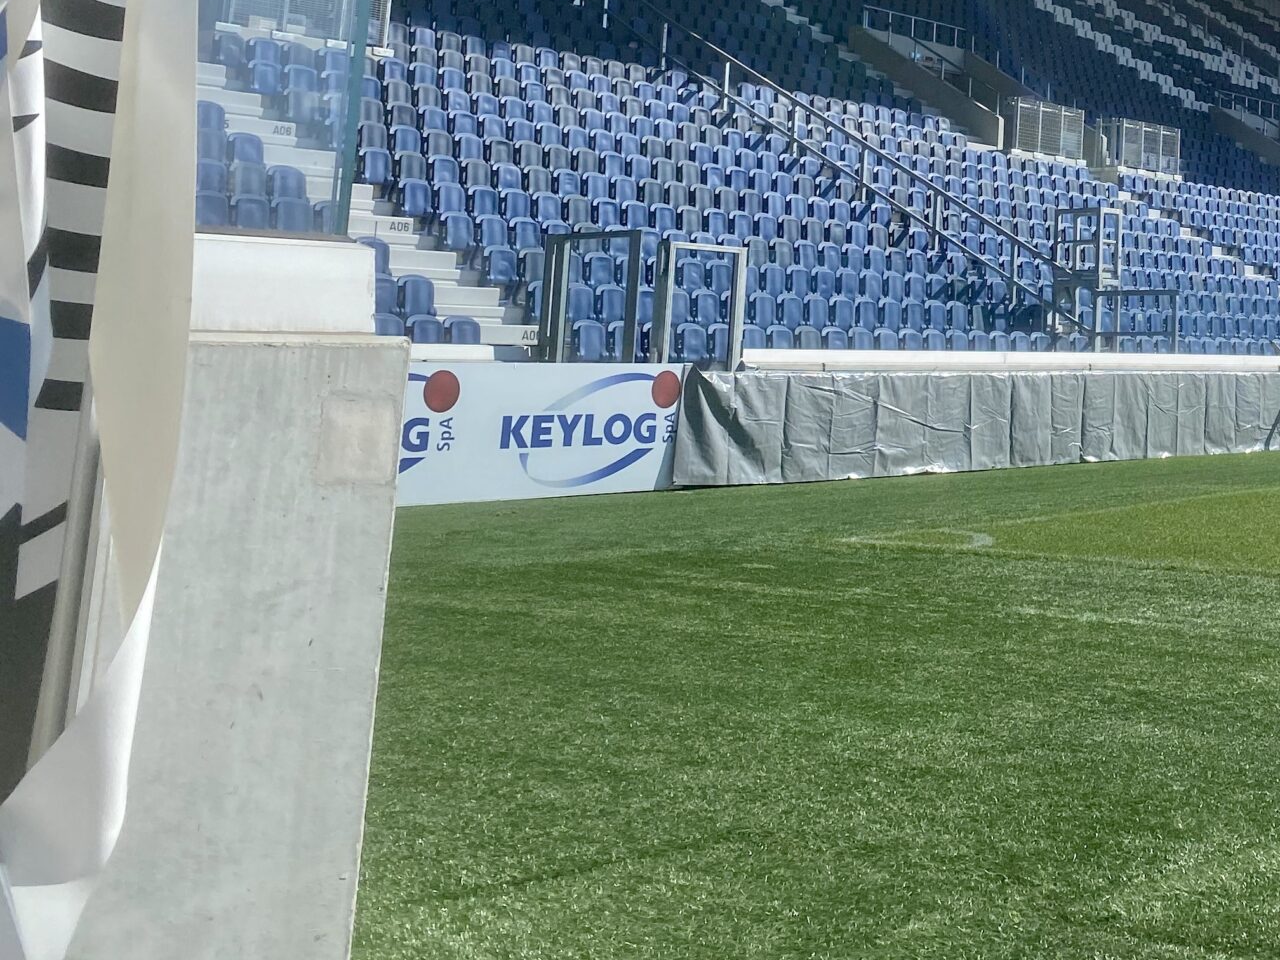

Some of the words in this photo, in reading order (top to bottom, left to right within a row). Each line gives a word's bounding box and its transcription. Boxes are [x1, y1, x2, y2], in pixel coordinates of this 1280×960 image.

[389, 221, 411, 232] A06
[436, 416, 454, 451] SpA
[499, 412, 657, 450] KEYLOG
